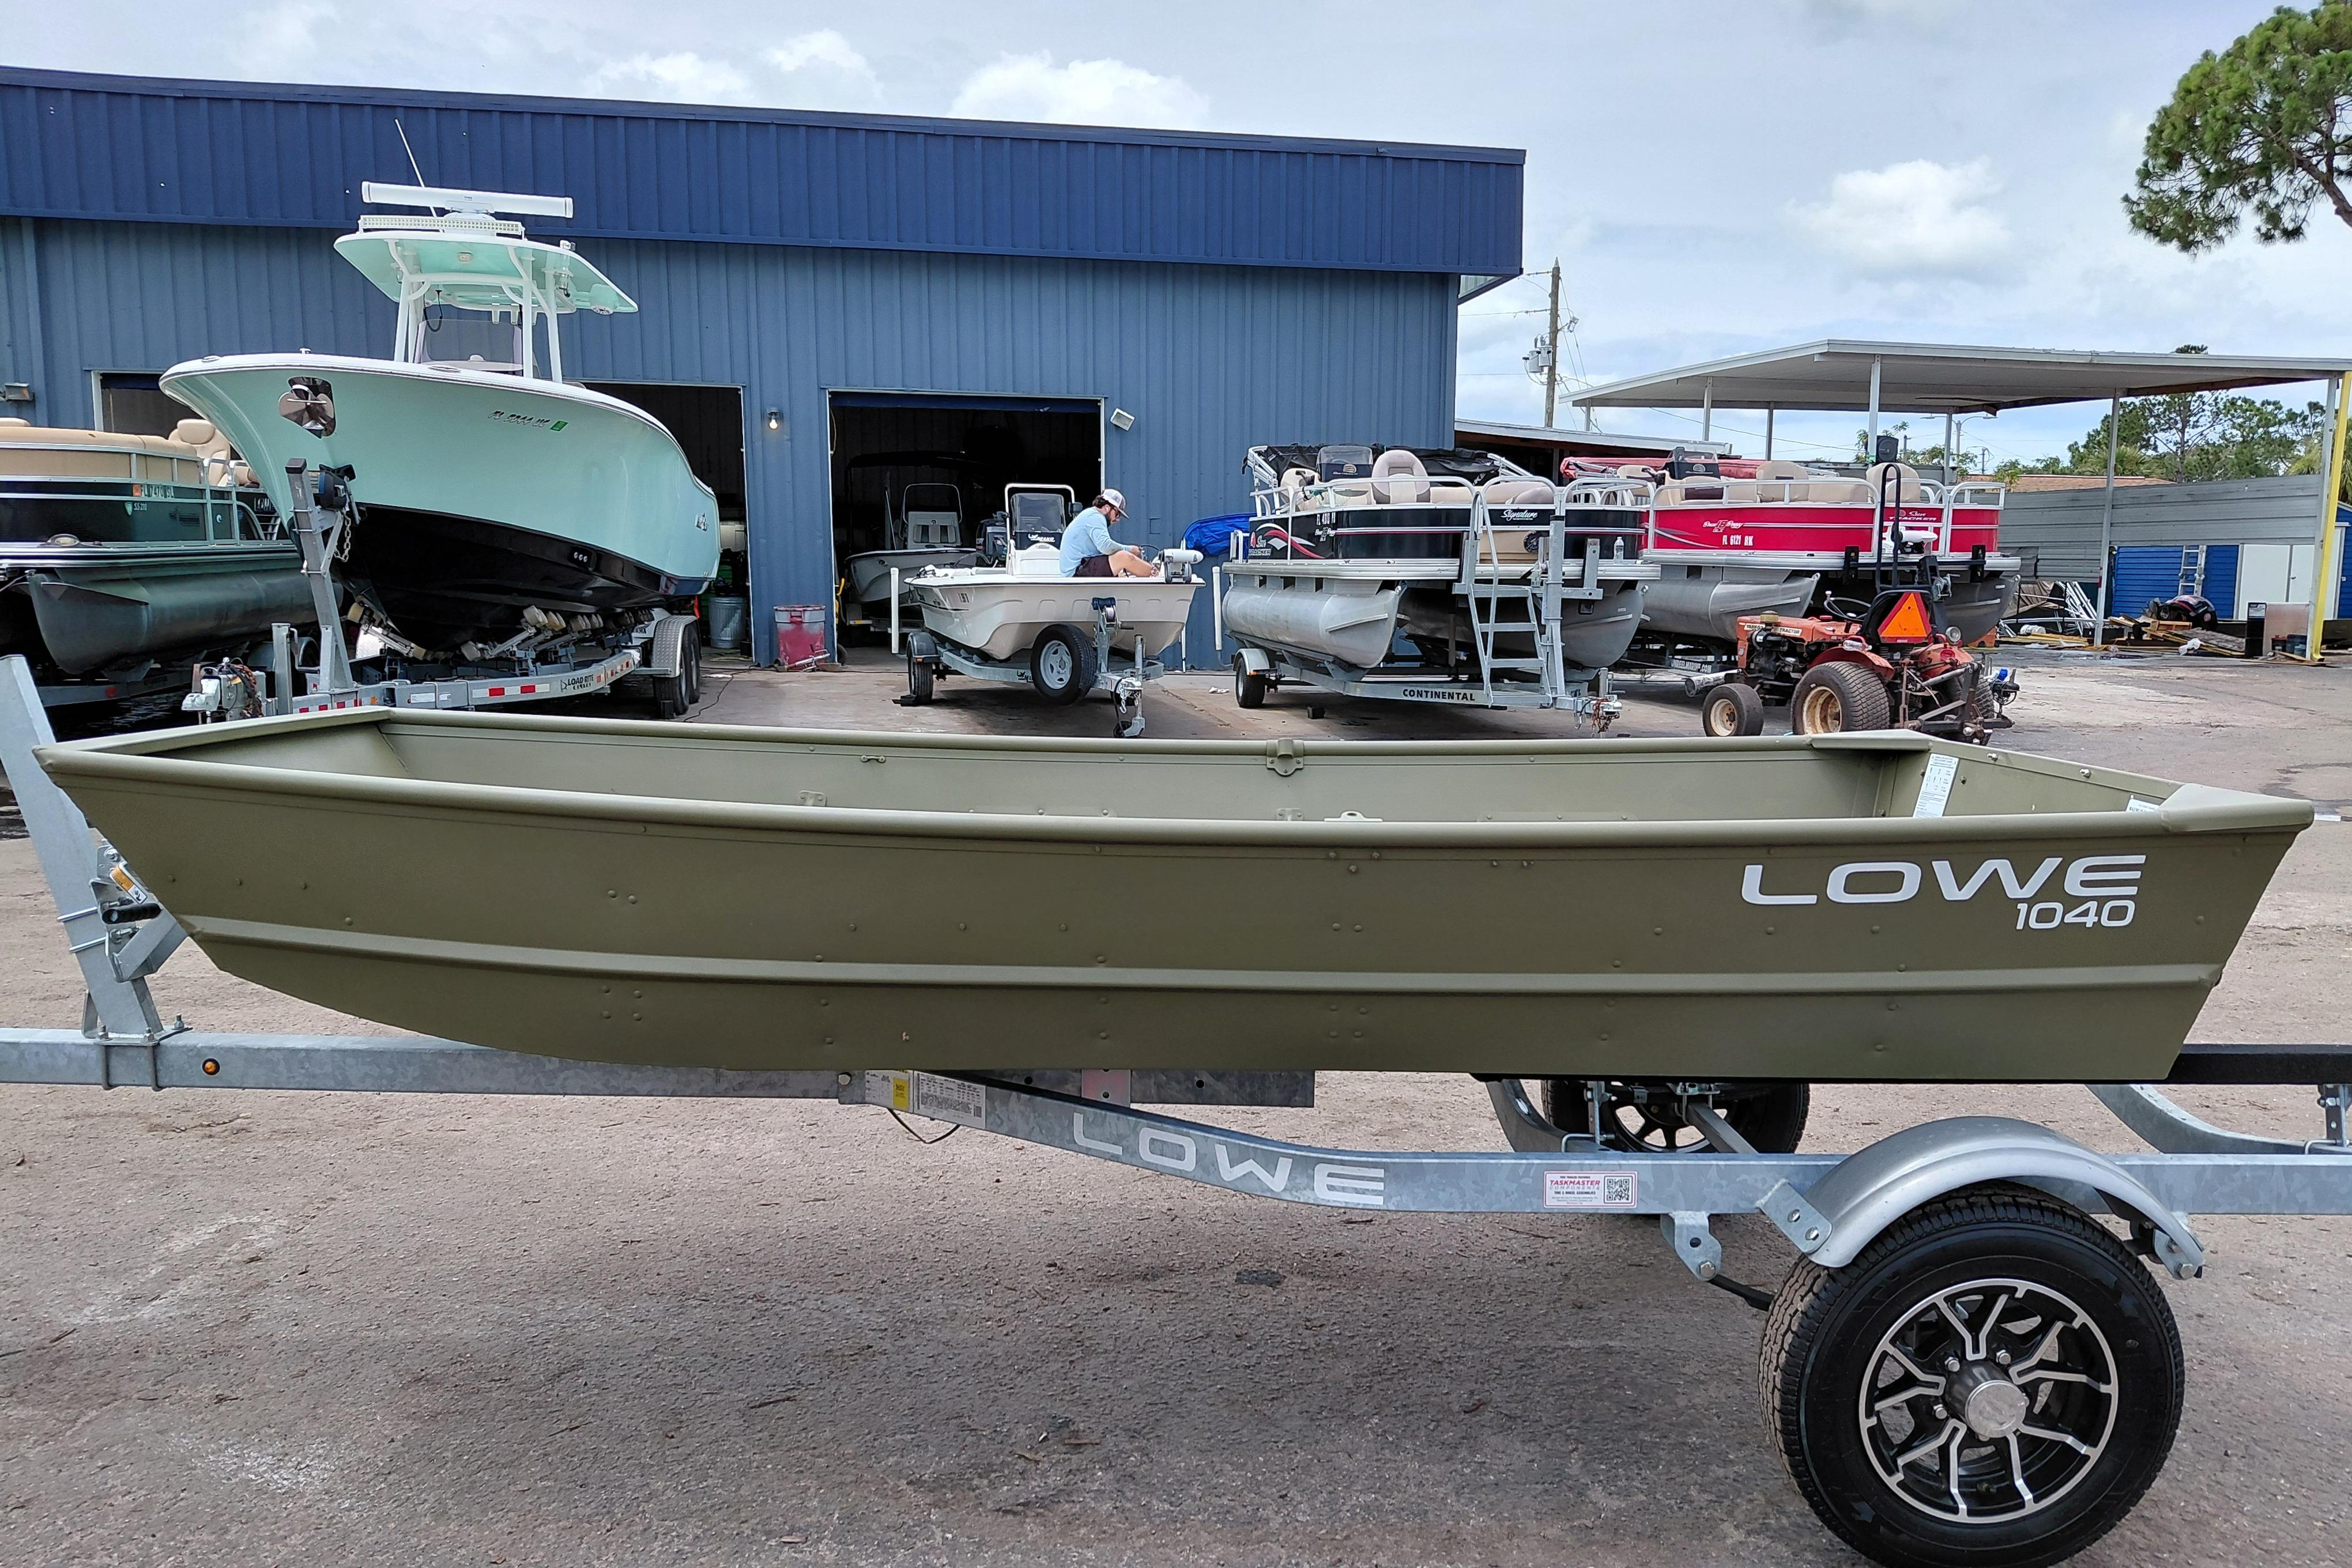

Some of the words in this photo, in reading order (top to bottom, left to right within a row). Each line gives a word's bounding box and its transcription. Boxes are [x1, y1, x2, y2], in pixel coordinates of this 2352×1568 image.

[1500, 509, 1538, 521] Signature
[1722, 535, 1728, 545] FL
[1730, 535, 1742, 545] 6121
[1744, 536, 1754, 546] RK
[568, 677, 583, 686] LOAD
[1403, 688, 1475, 701] CONTINENTAL
[1741, 854, 2146, 905] LOWE
[2016, 899, 2136, 930] 1040
[1073, 1112, 1384, 1205] LOWE
